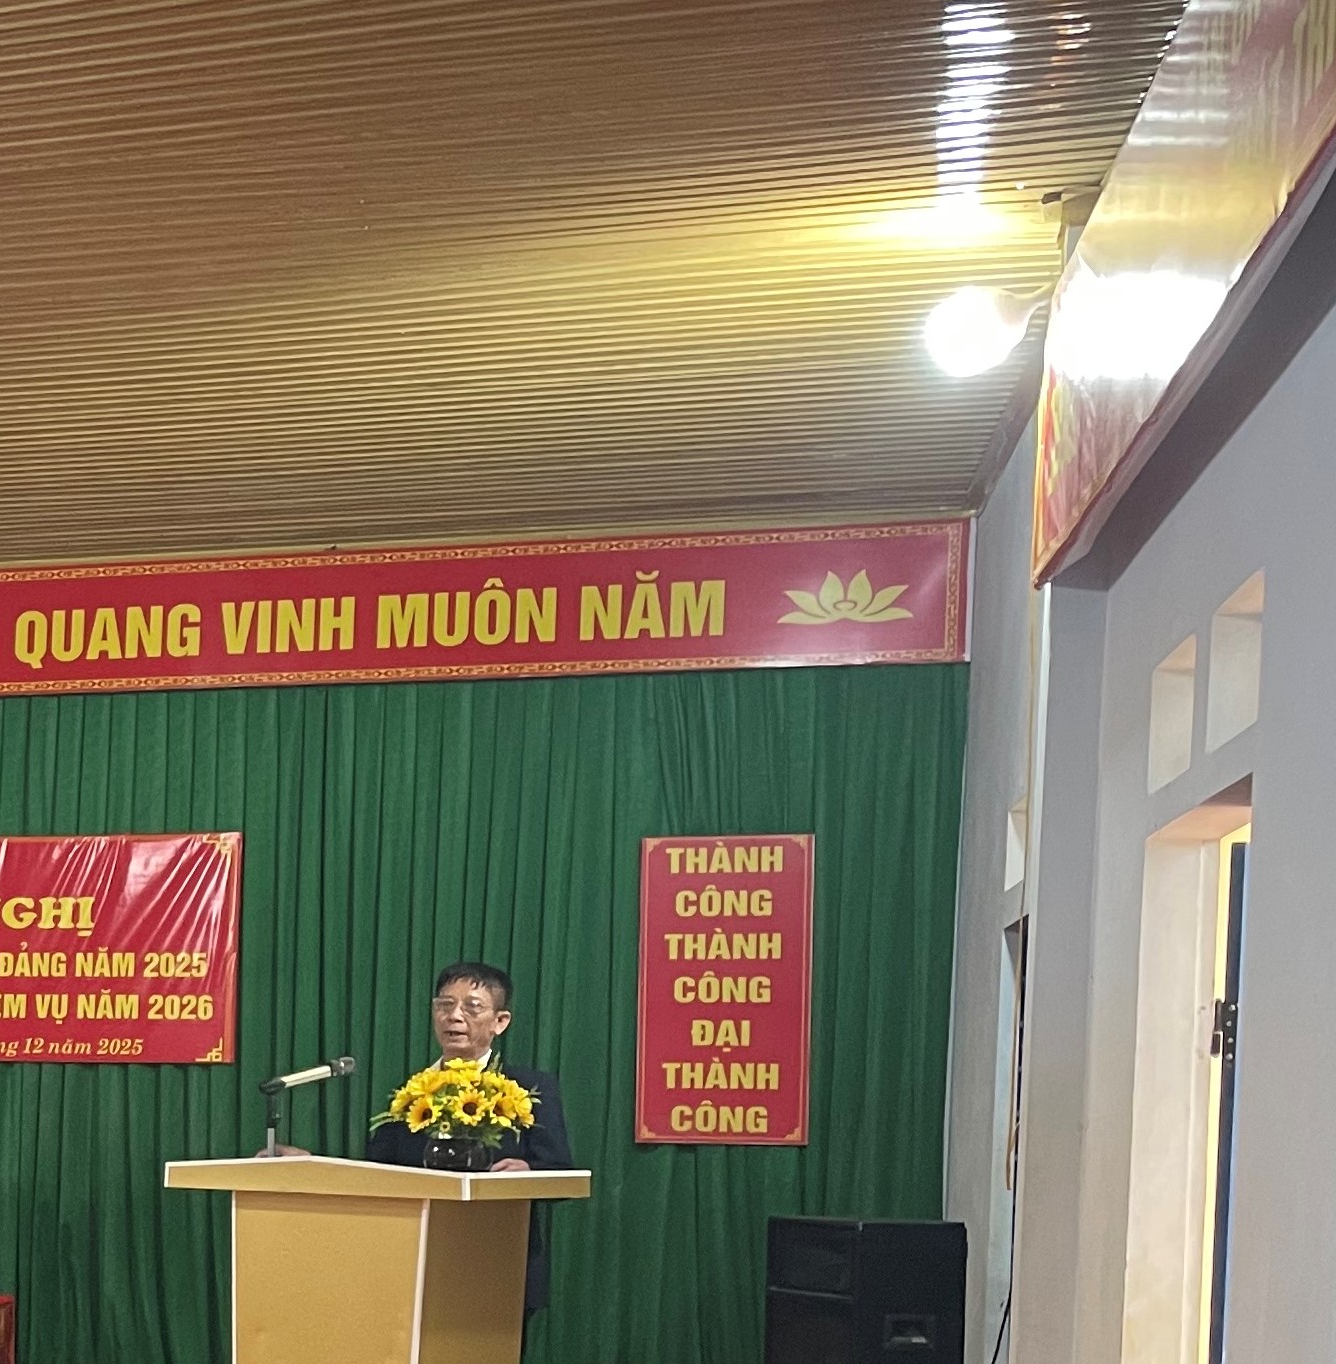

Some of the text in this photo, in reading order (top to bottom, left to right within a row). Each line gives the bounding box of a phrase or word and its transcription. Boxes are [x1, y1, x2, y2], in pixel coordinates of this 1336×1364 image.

[13, 602, 202, 667] QUANG
[221, 596, 354, 655] VINH
[377, 578, 558, 649] MUÔN
[579, 570, 725, 642] NĂM
[666, 841, 783, 874] THÀNH
[676, 885, 772, 916] CÔNG
[664, 928, 781, 960] THÀNH
[75, 947, 135, 977] NĂM
[143, 952, 207, 978] 2025
[674, 971, 771, 1003] CÔNG
[36, 994, 68, 1024] VỤ
[77, 989, 139, 1019] NĂM
[148, 995, 213, 1020] 2026
[25, 1038, 44, 1054] 12
[48, 1039, 91, 1055] năm
[97, 1039, 143, 1055] 2025
[691, 1020, 750, 1052] ĐẠI
[662, 1057, 778, 1090] THÀNH
[671, 1100, 767, 1133] CÔNG
